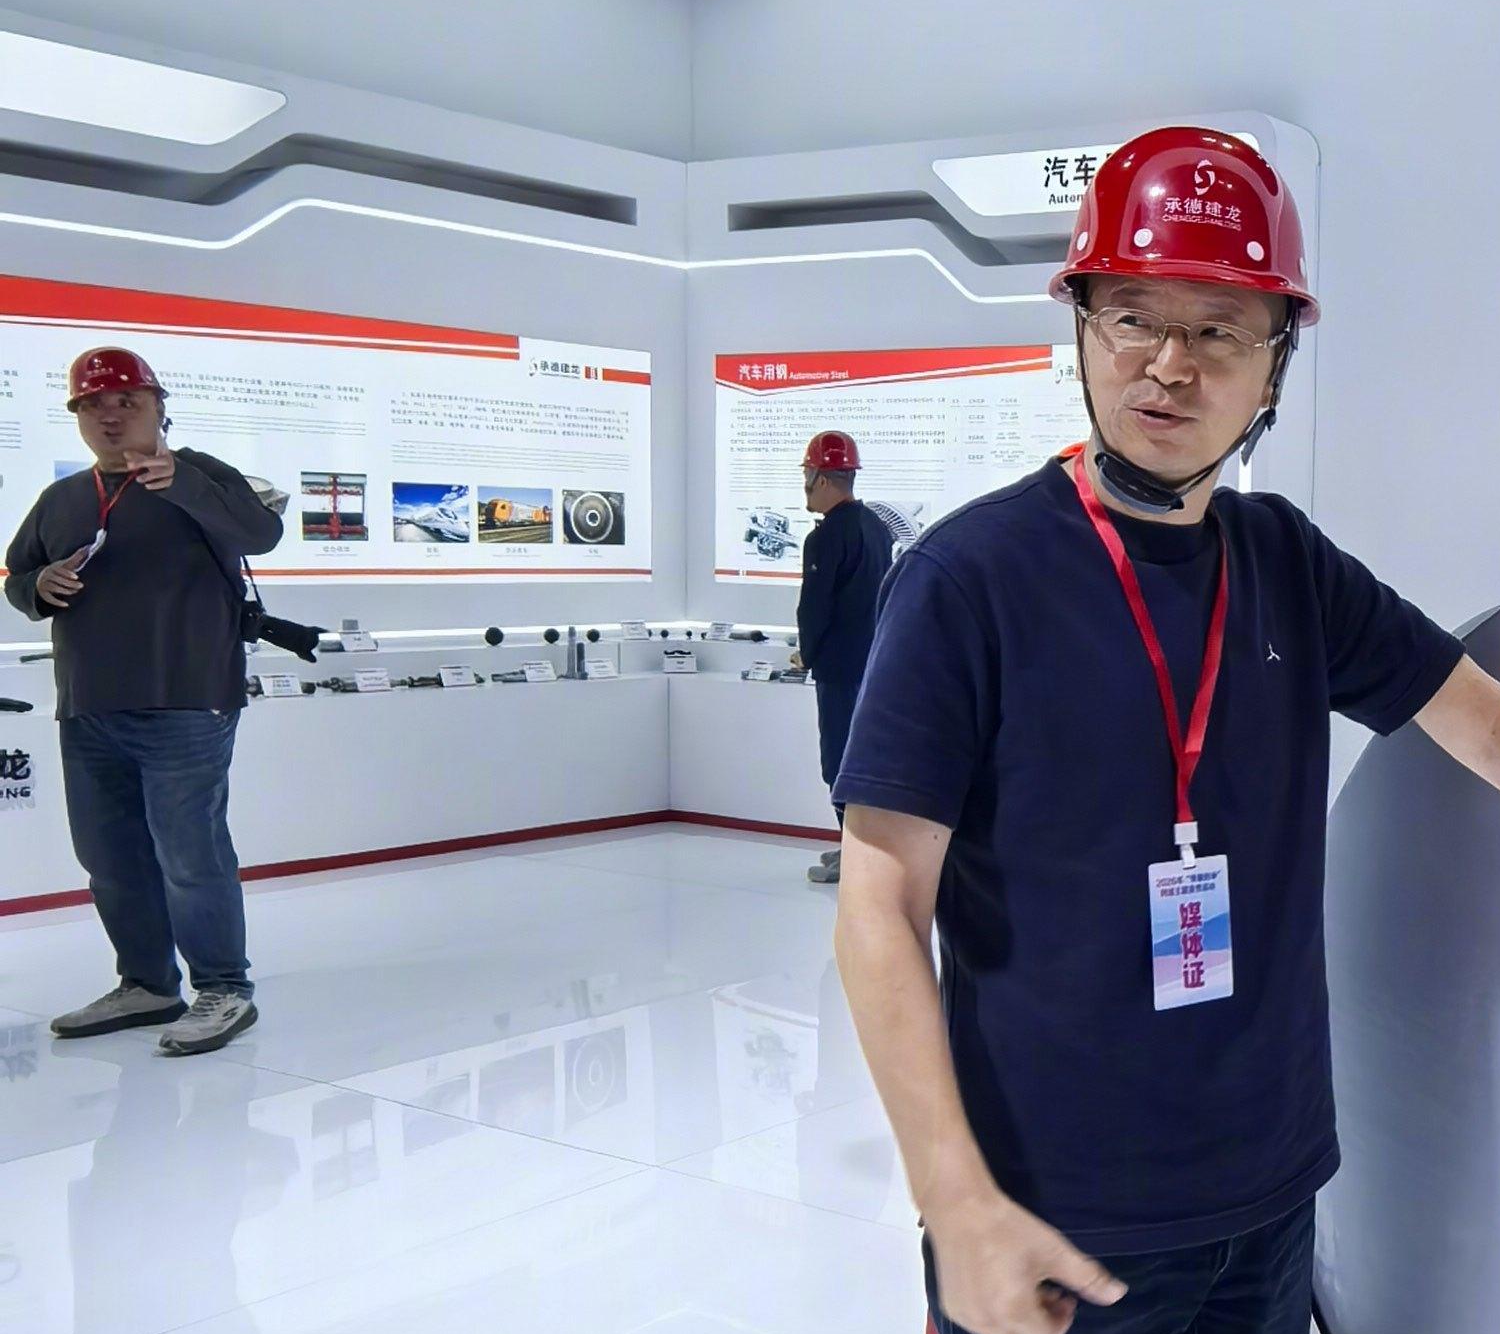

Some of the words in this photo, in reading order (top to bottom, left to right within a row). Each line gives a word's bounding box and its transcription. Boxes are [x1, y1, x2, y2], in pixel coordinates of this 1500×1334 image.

[1043, 153, 1112, 188] 汽车
[1049, 193, 1085, 205] Autom
[1164, 197, 1242, 222] 承德建龙
[739, 364, 787, 381] 汽车用钢
[1179, 901, 1205, 989] 媒体证
